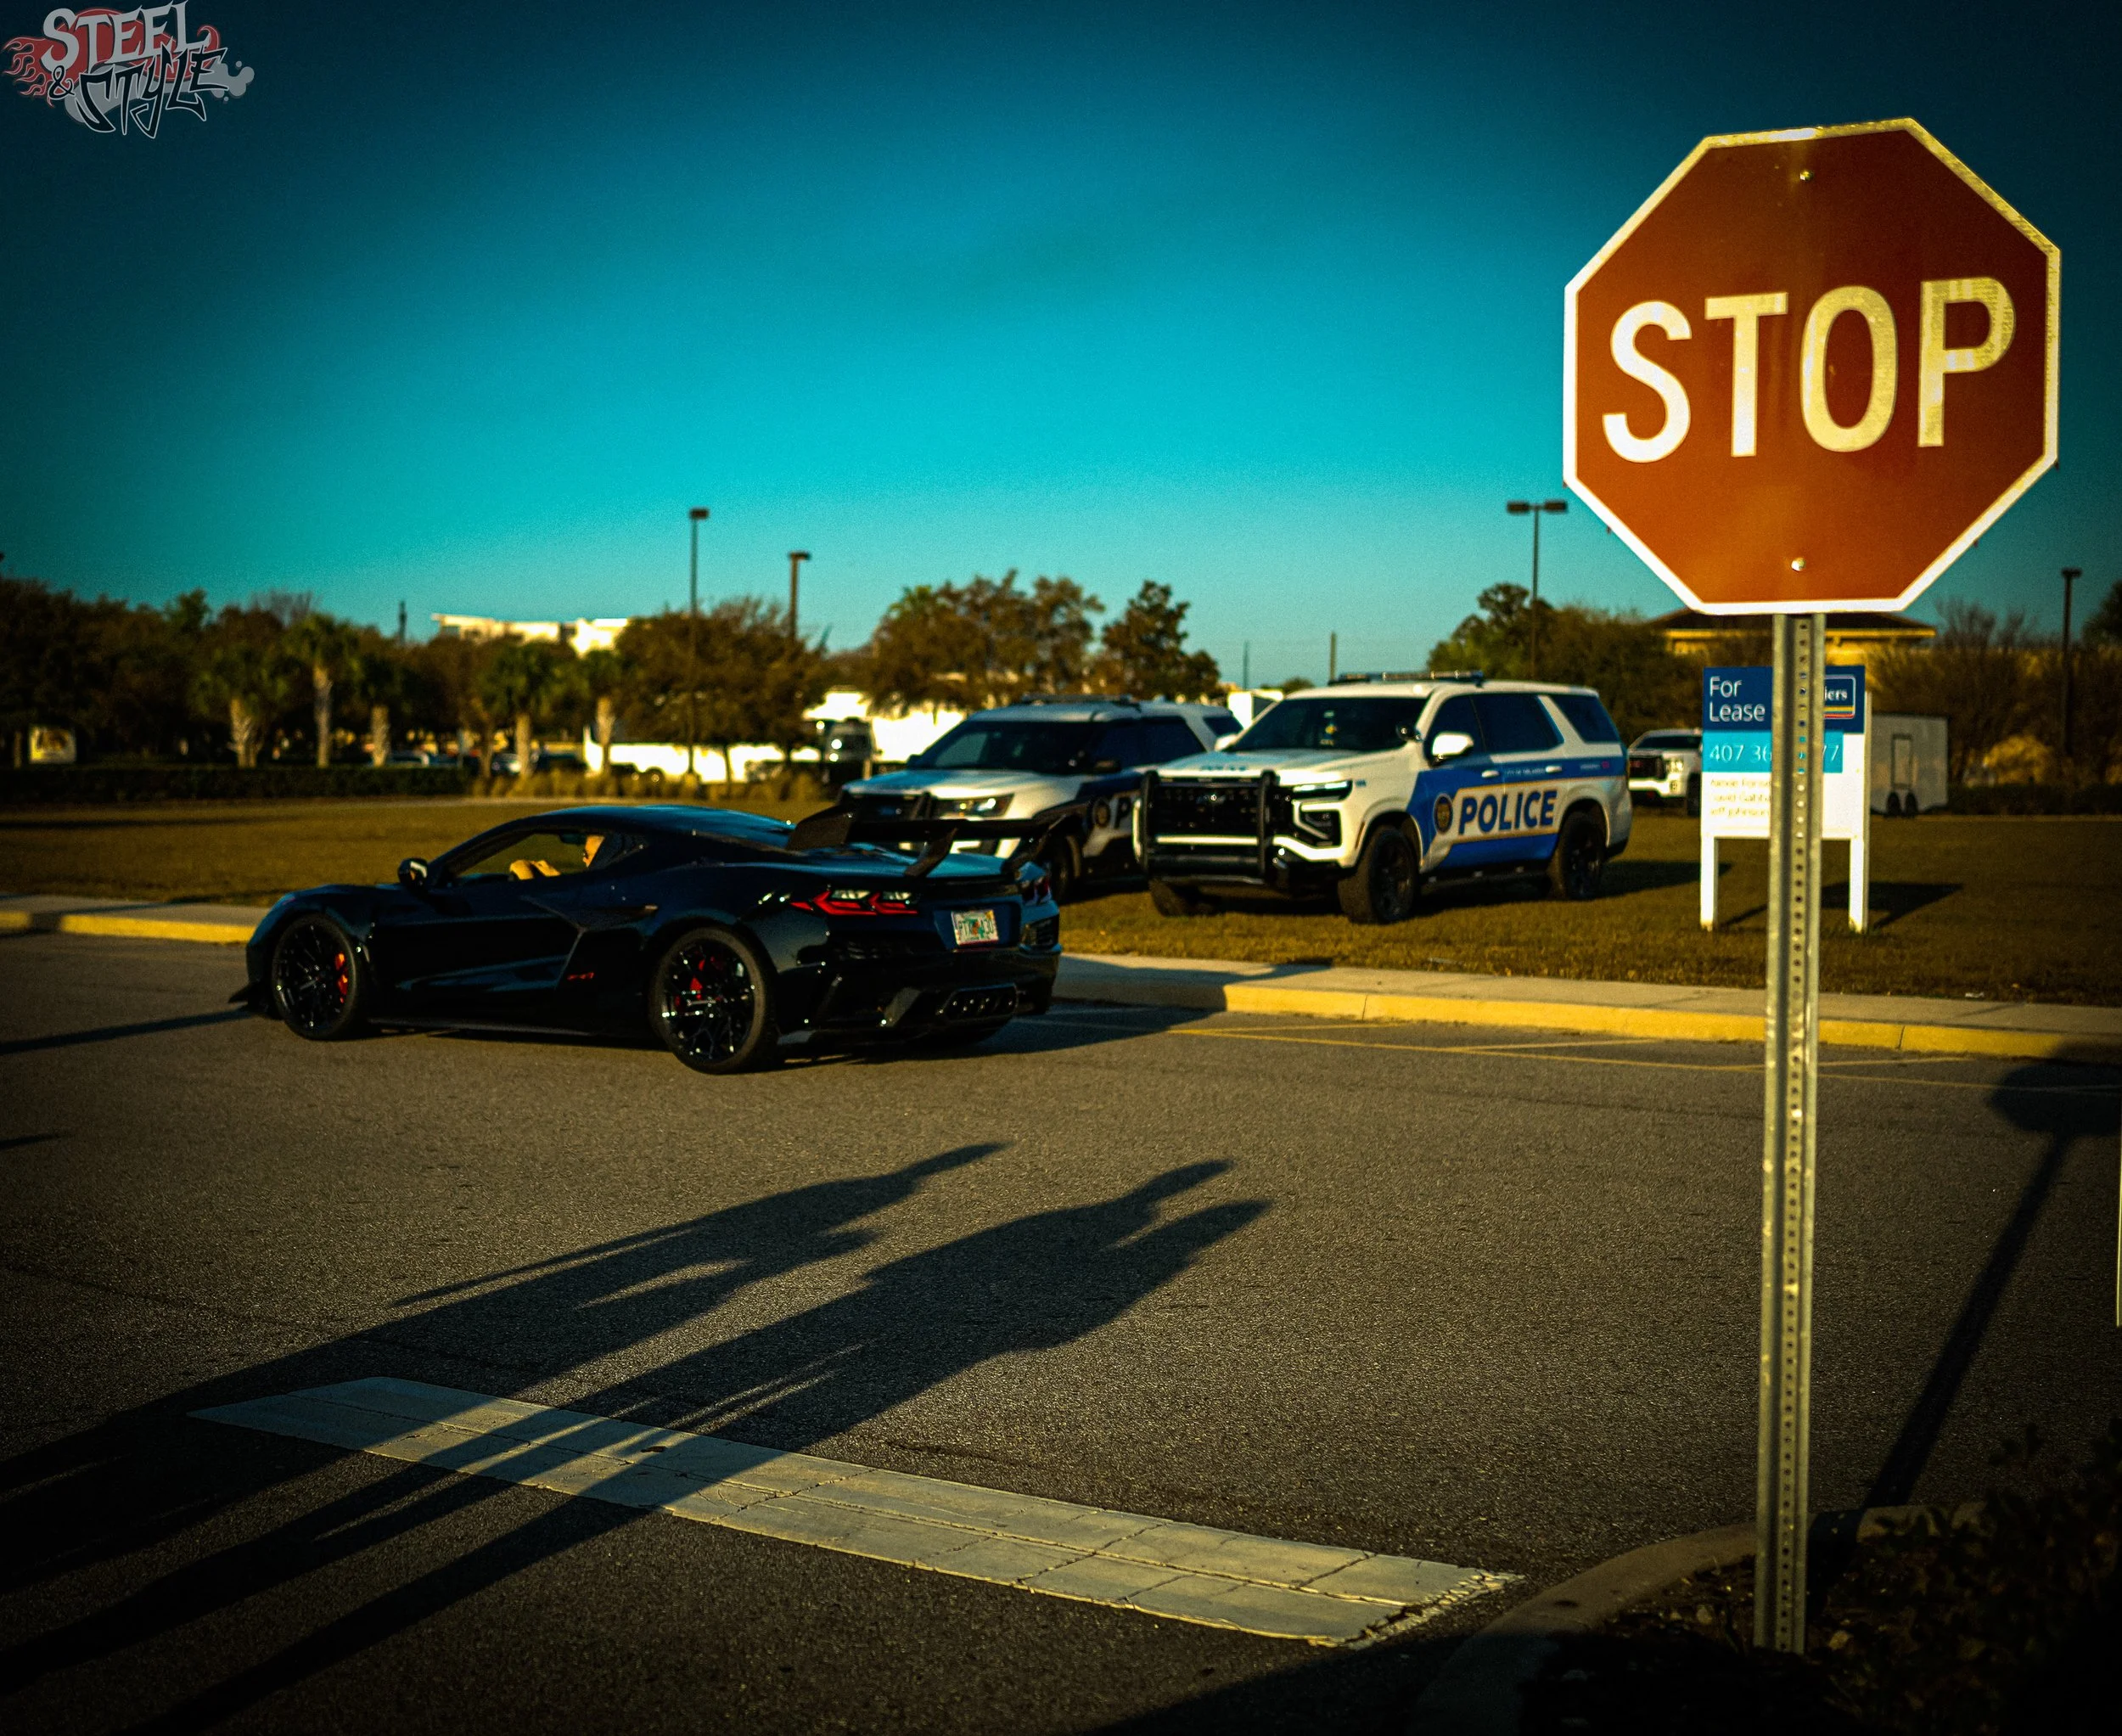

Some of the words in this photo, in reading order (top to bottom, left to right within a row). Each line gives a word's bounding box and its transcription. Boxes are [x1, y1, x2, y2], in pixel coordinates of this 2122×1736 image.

[1602, 276, 2017, 463] STOP
[1709, 675, 1743, 698] For
[1709, 701, 1766, 723] Lease
[1709, 744, 1745, 762] 407
[1458, 790, 1558, 836] POLICE
